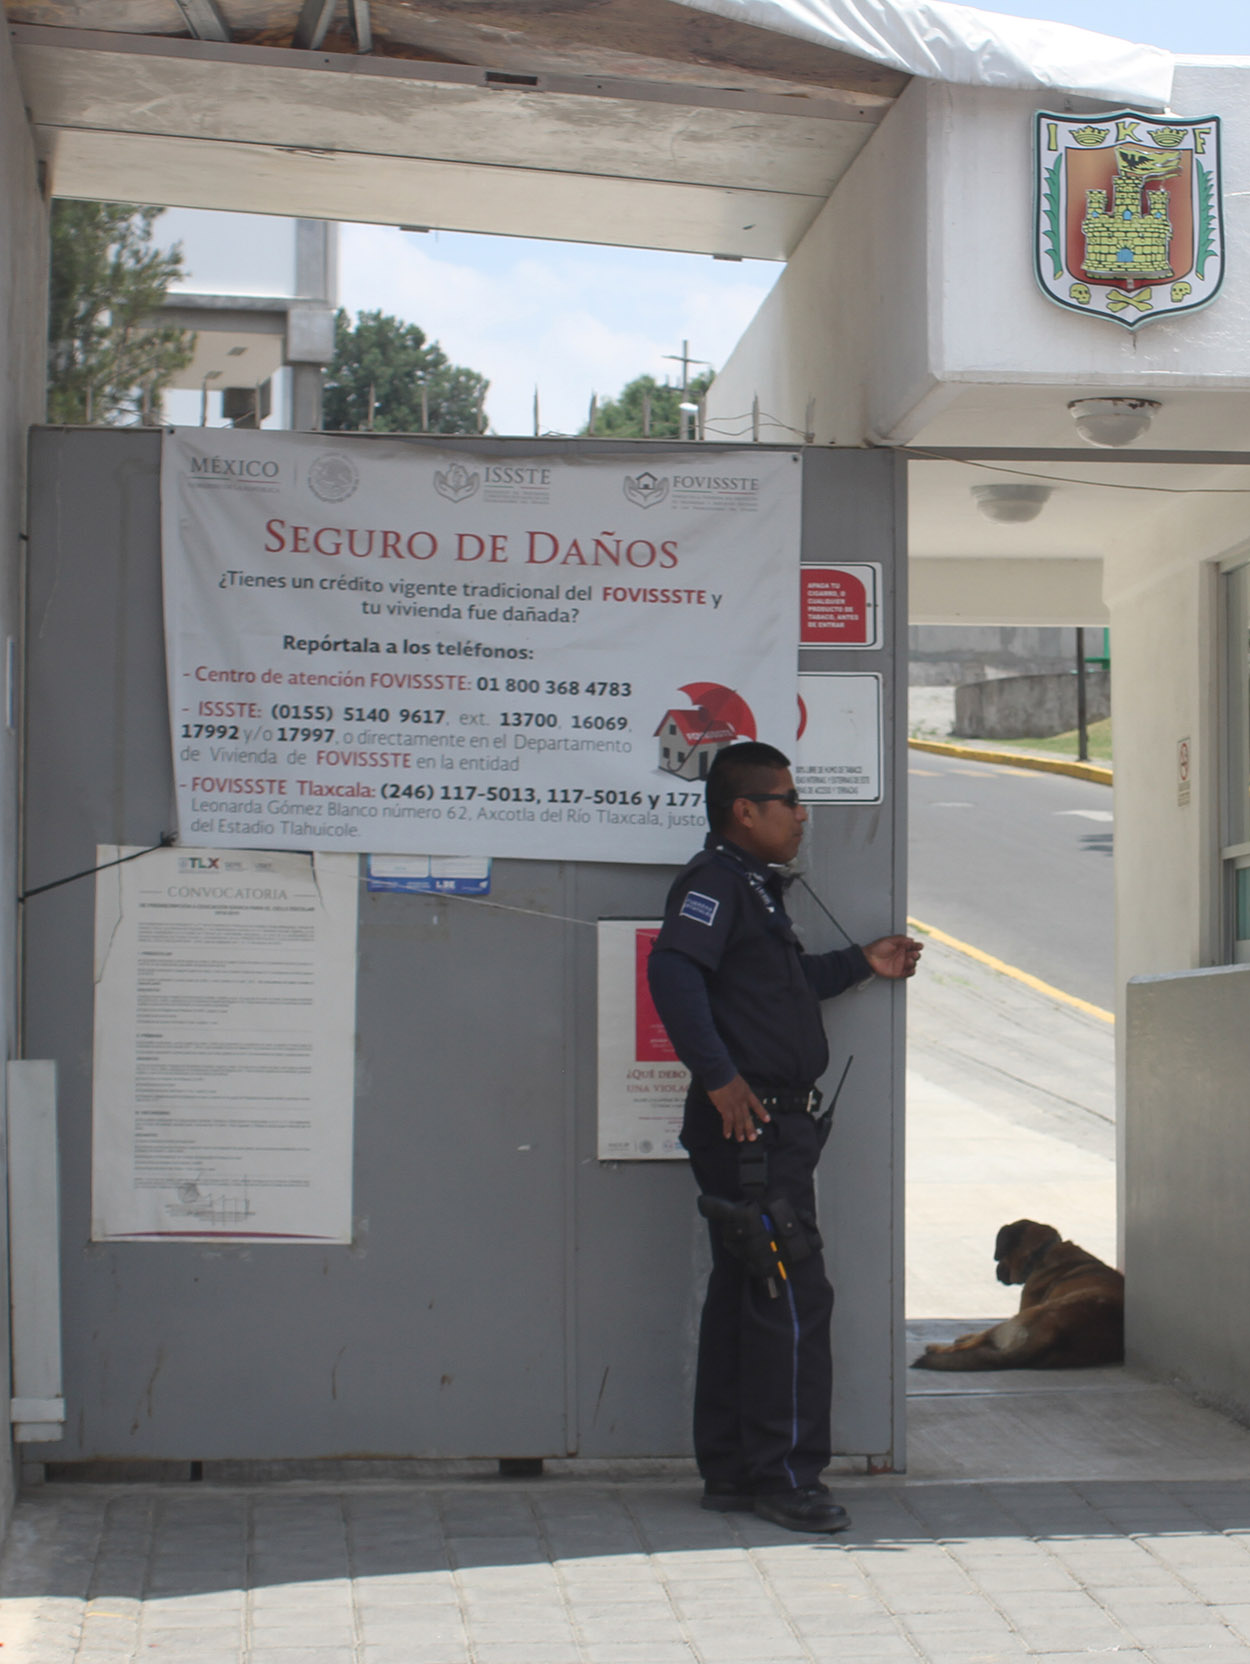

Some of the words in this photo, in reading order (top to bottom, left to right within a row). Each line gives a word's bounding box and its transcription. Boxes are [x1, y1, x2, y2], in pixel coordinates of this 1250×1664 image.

[191, 455, 279, 478] MÉXICO
[484, 466, 551, 485] ISSSTE
[673, 475, 760, 491] FOVISSSTE
[218, 570, 287, 590] ¿Tienes
[291, 577, 316, 590] un
[319, 574, 384, 593] crédito
[389, 580, 457, 599] vigente
[462, 583, 560, 602] tradicional
[565, 585, 592, 602] del
[602, 586, 707, 605] FOVISSSTE
[711, 592, 723, 609] y
[361, 601, 381, 615] tu
[386, 601, 462, 620] vivienda
[468, 604, 497, 621] fue
[502, 605, 580, 623] dañada?
[283, 634, 381, 655] Repórtala
[385, 642, 397, 654] a
[403, 639, 431, 655] los
[436, 640, 534, 660] teléfonos:
[195, 666, 256, 684] Centro
[261, 669, 283, 684] de
[287, 670, 365, 688] atención
[370, 672, 472, 691] FOVISSSTE:
[476, 677, 500, 692] 01
[505, 678, 540, 694] 800
[545, 680, 580, 696] 368
[585, 681, 632, 697] 4783
[198, 701, 262, 719] ISSSTE:
[271, 703, 334, 722] (0155)
[343, 707, 389, 723] 5140
[459, 712, 490, 726] ext.
[181, 724, 239, 740] 17992
[243, 725, 273, 743] y/o
[343, 733, 353, 745] o
[357, 730, 466, 748] directamente
[469, 737, 489, 749] en
[493, 734, 507, 749] el
[514, 734, 632, 754] Departamento
[180, 747, 200, 762] de
[210, 747, 277, 765] Vivienda
[287, 752, 307, 766] de
[316, 750, 412, 769] FOVISSSTE
[416, 756, 436, 769] en
[440, 756, 454, 771] la
[459, 756, 520, 772] entidad
[191, 777, 287, 796] FOVISSSTE
[296, 780, 377, 798] Tlaxcala:
[381, 782, 435, 801] (246)
[441, 786, 541, 805] 117-5013,
[547, 788, 643, 806] 117-5016
[648, 795, 661, 810] y
[191, 799, 262, 814] Leonarda
[267, 800, 322, 816] Gómez
[327, 802, 378, 818] Blanco
[382, 803, 442, 820] número
[476, 807, 535, 822] Axcotla
[540, 808, 563, 823] del
[567, 807, 591, 824] Río
[667, 811, 706, 829] justo
[190, 819, 213, 833] del
[218, 819, 275, 835] Estadio
[280, 820, 361, 838] Tlahuicole.
[188, 857, 221, 869] TLX
[167, 886, 288, 900] CONVOCATORIA
